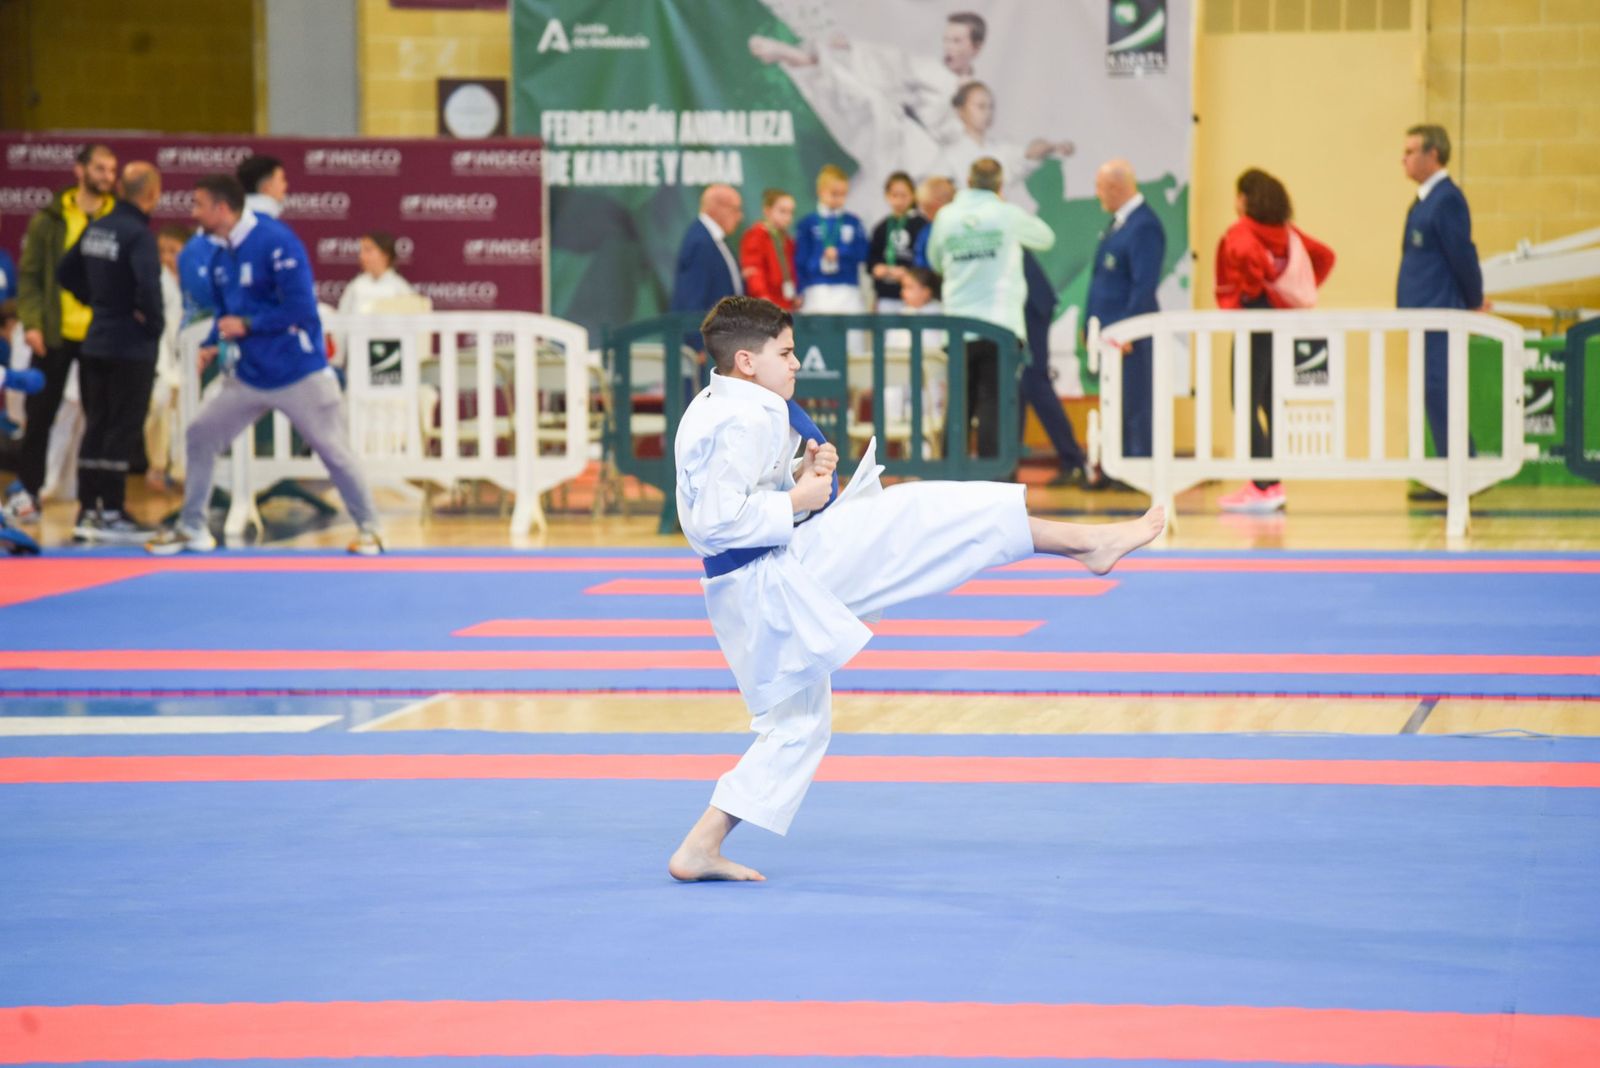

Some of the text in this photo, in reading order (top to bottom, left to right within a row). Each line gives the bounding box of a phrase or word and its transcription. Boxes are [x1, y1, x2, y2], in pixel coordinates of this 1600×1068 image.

[541, 104, 795, 145] FEDERACIÓN ANDALUZA
[573, 151, 661, 186] KARATE
[661, 151, 680, 186] Y
